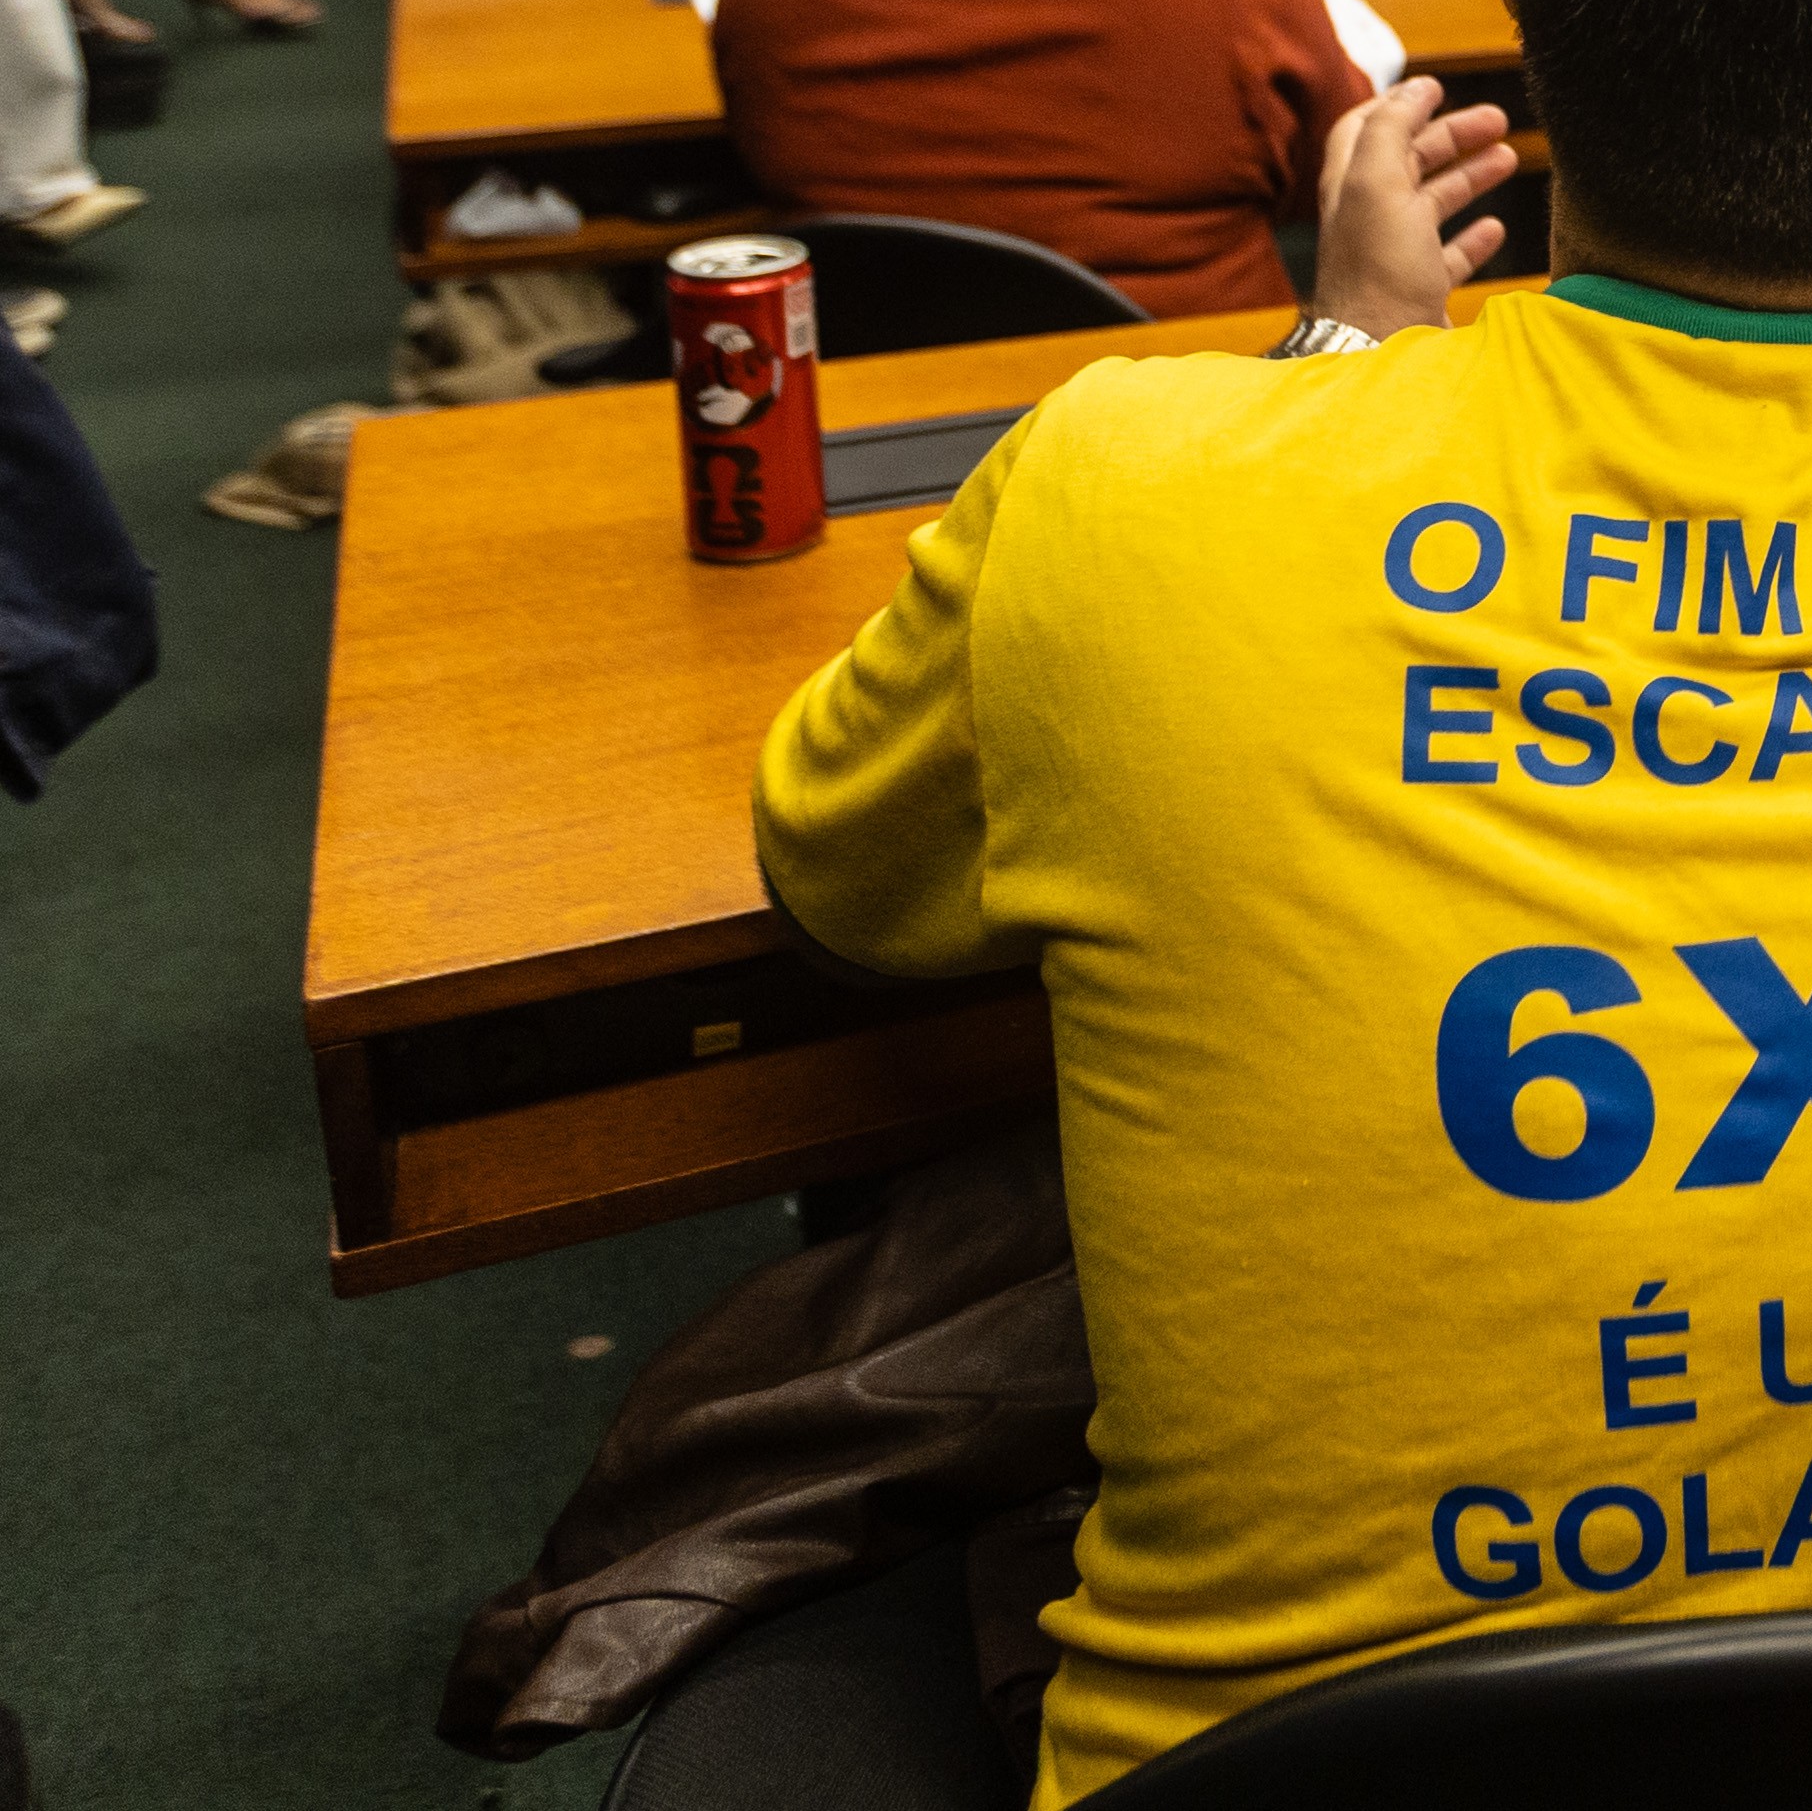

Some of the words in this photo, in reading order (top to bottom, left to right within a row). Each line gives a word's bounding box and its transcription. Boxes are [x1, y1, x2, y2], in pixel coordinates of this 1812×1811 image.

[1384, 502, 1506, 613] O
[1562, 513, 1802, 635] FIM
[1600, 1280, 1697, 1430] É
